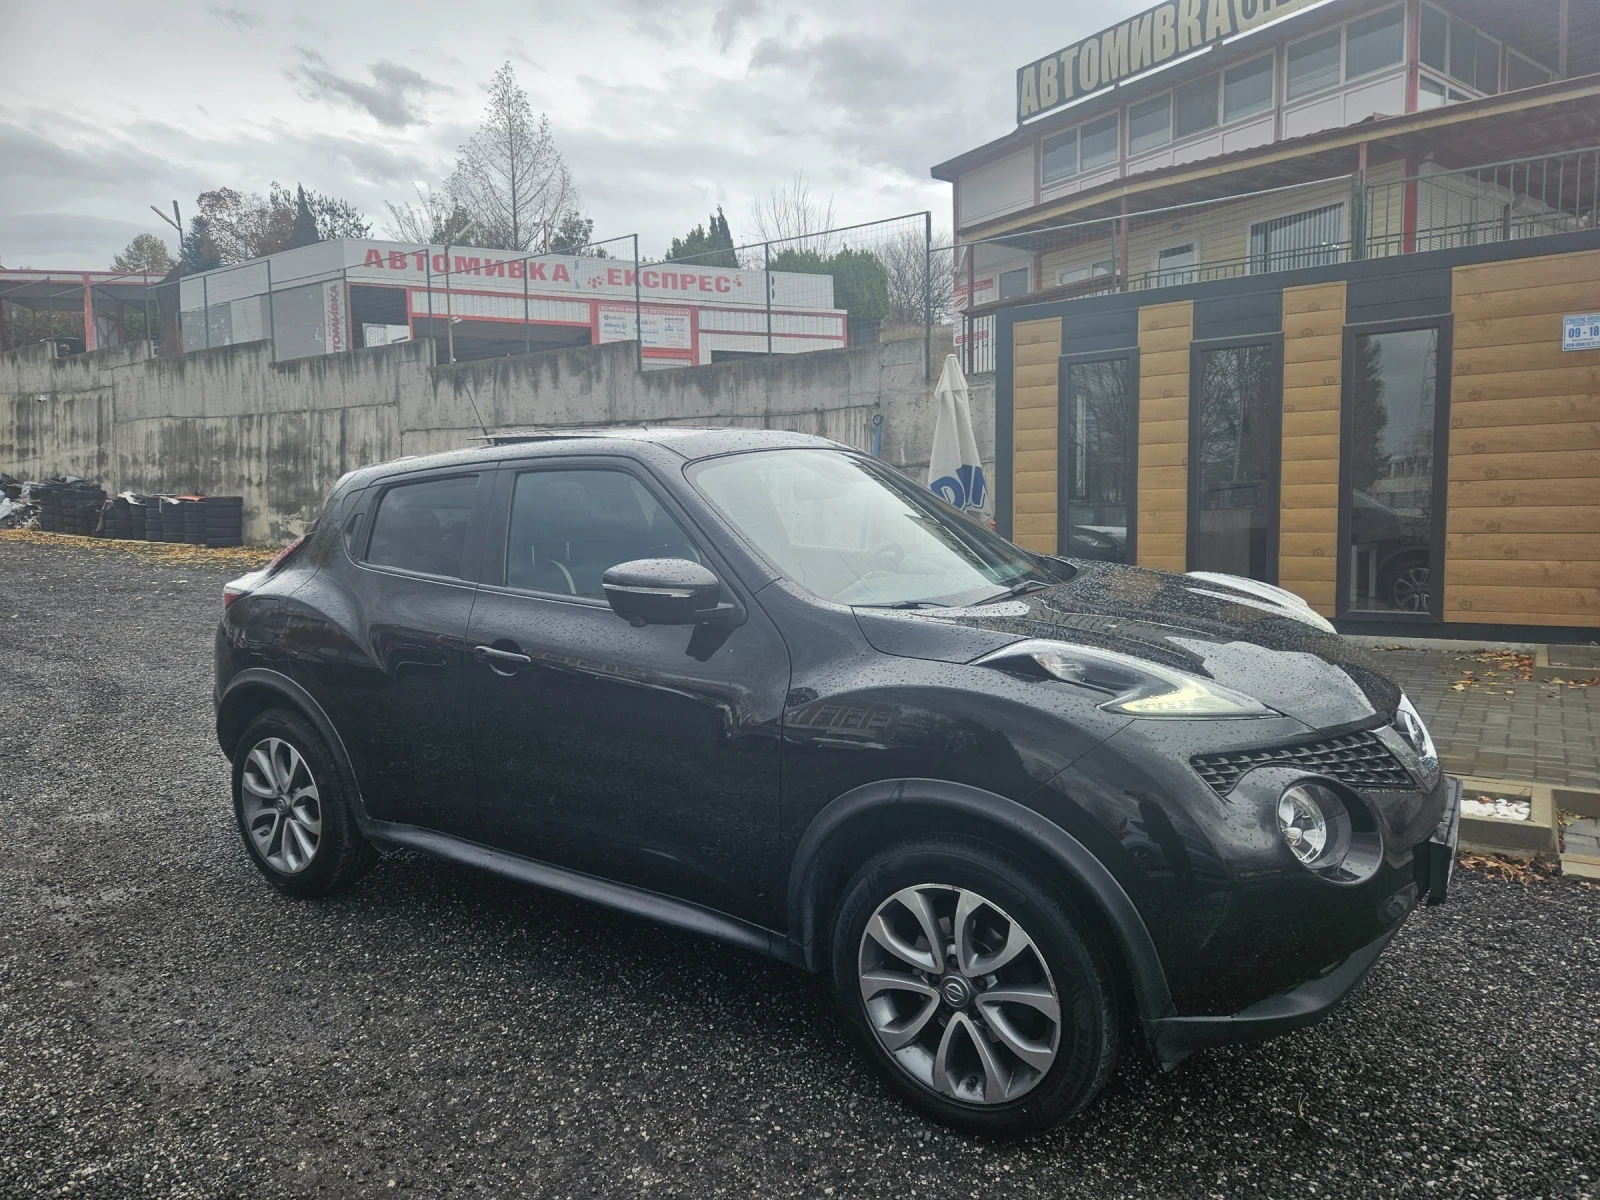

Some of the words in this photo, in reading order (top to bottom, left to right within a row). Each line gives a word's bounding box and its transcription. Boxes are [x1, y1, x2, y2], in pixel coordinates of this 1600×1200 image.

[1020, 0, 1232, 118] АВТОМИВКА
[364, 248, 571, 283] АВТОМИВКА
[607, 267, 731, 293] ЕКСПРЕС
[329, 284, 342, 352] ТОМИВКА
[1568, 327, 1581, 338] 09
[1589, 325, 1600, 337] 18
